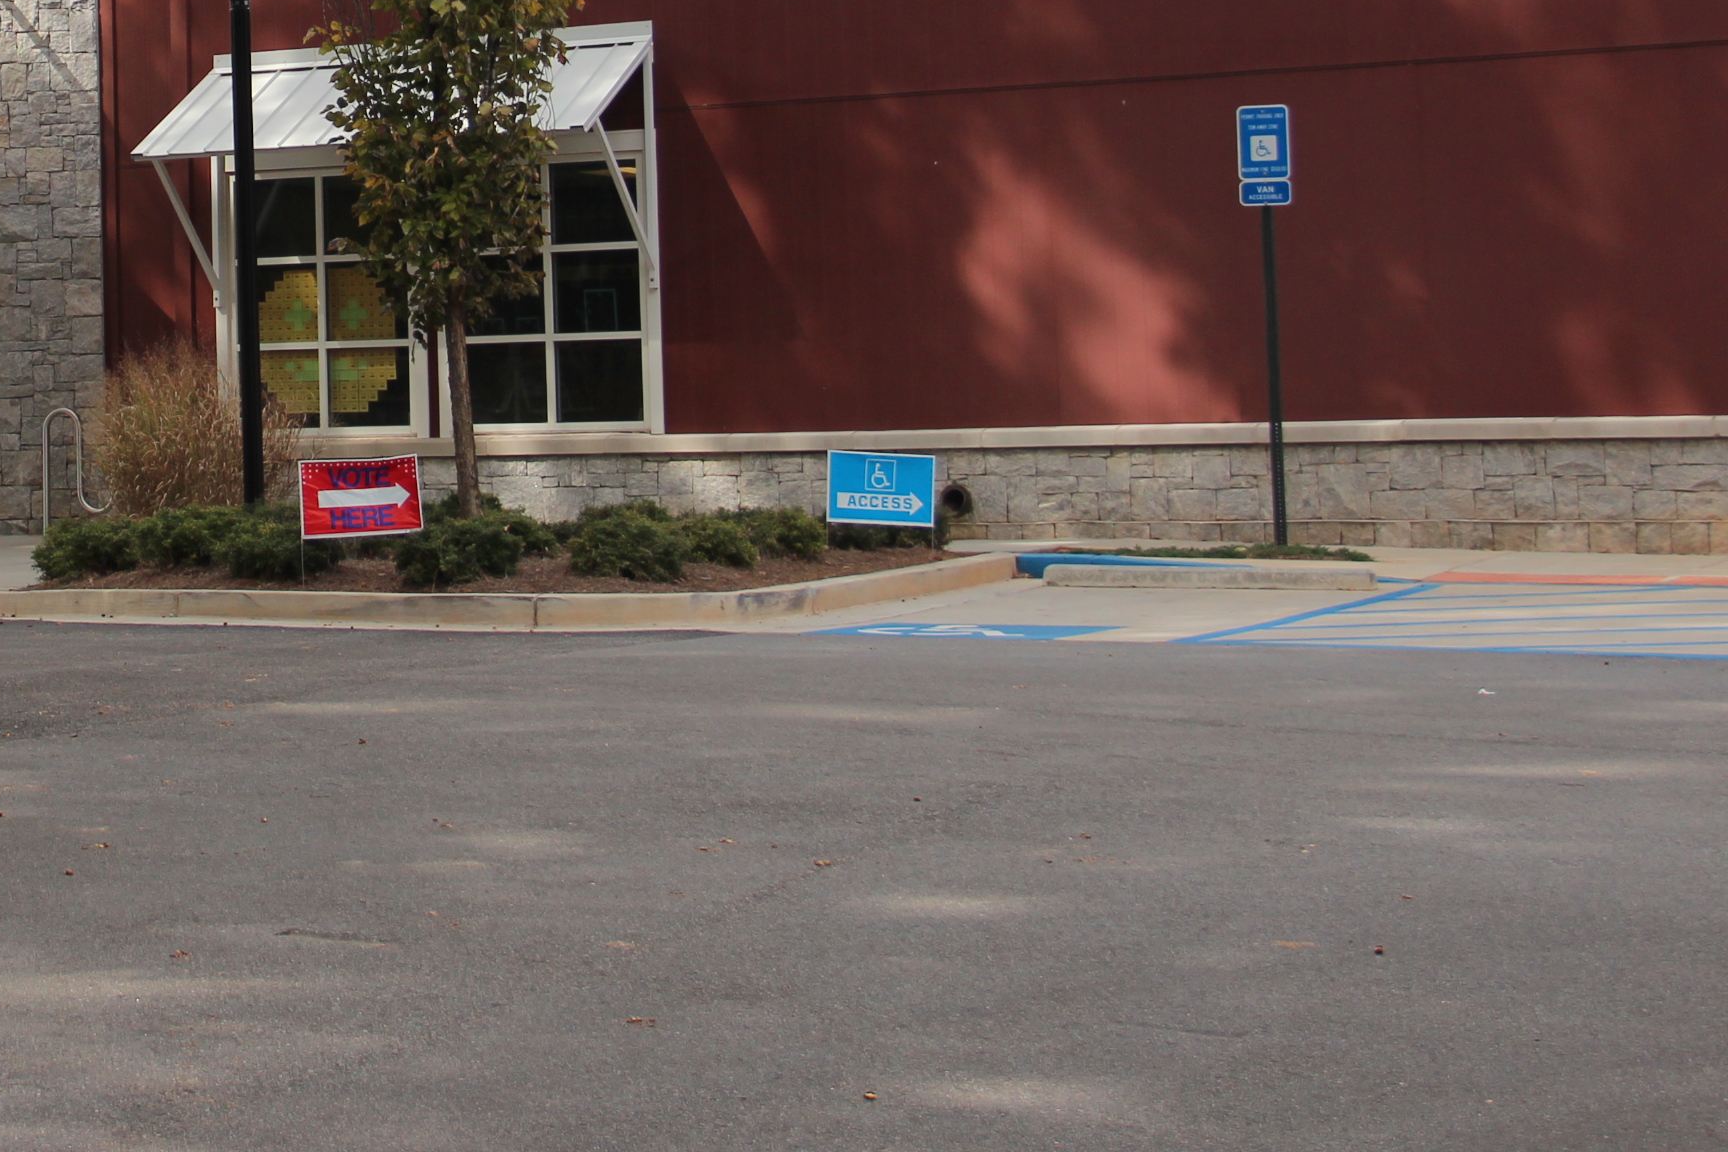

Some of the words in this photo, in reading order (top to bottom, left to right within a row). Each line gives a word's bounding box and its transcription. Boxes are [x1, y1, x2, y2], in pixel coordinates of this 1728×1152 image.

[327, 465, 391, 488] VOTE
[847, 494, 913, 510] ACCESS
[330, 506, 396, 530] HERE
